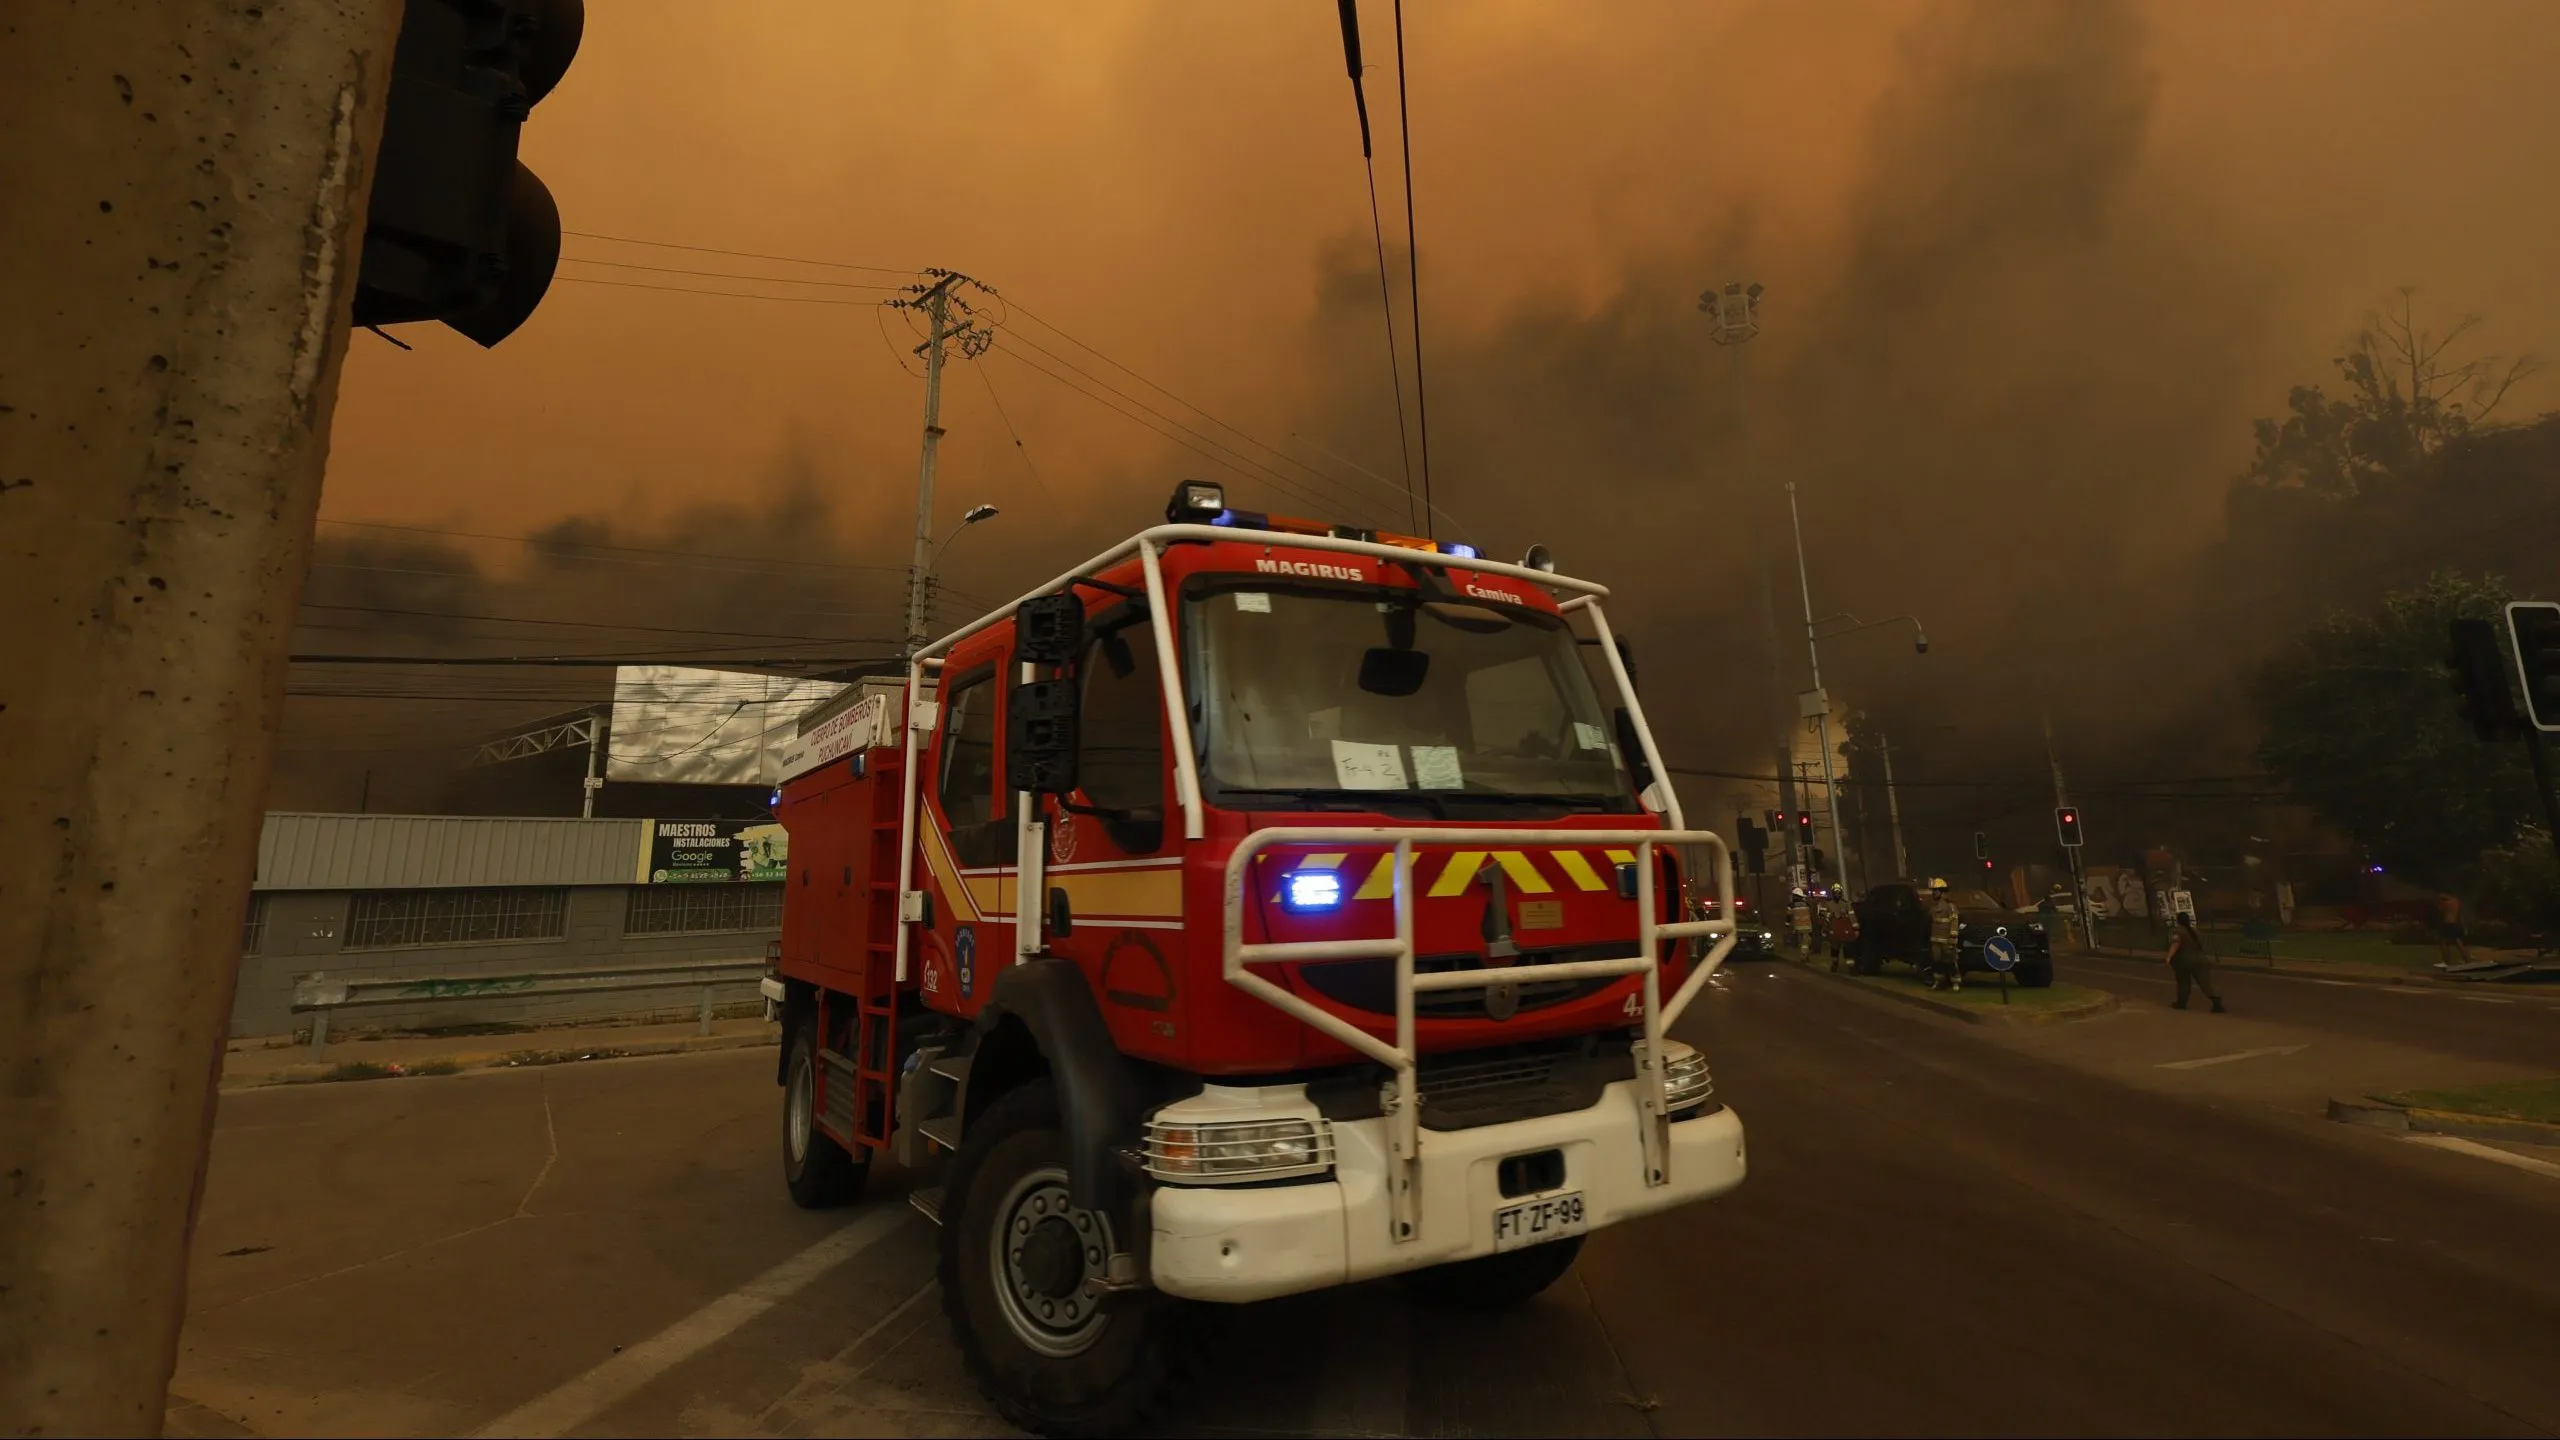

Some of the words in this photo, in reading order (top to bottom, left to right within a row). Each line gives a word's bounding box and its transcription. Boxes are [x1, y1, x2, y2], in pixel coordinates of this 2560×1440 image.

[1256, 559, 1363, 582] MAGIRUS
[1466, 584, 1523, 605] Camiva
[810, 722, 831, 746] CUERPO
[829, 718, 839, 736] DE
[838, 700, 872, 733] BOMBEROS
[658, 823, 716, 837] MAESTROS
[673, 837, 730, 848] INSTALACIONES
[671, 850, 713, 862] Google
[926, 970, 938, 989] 132
